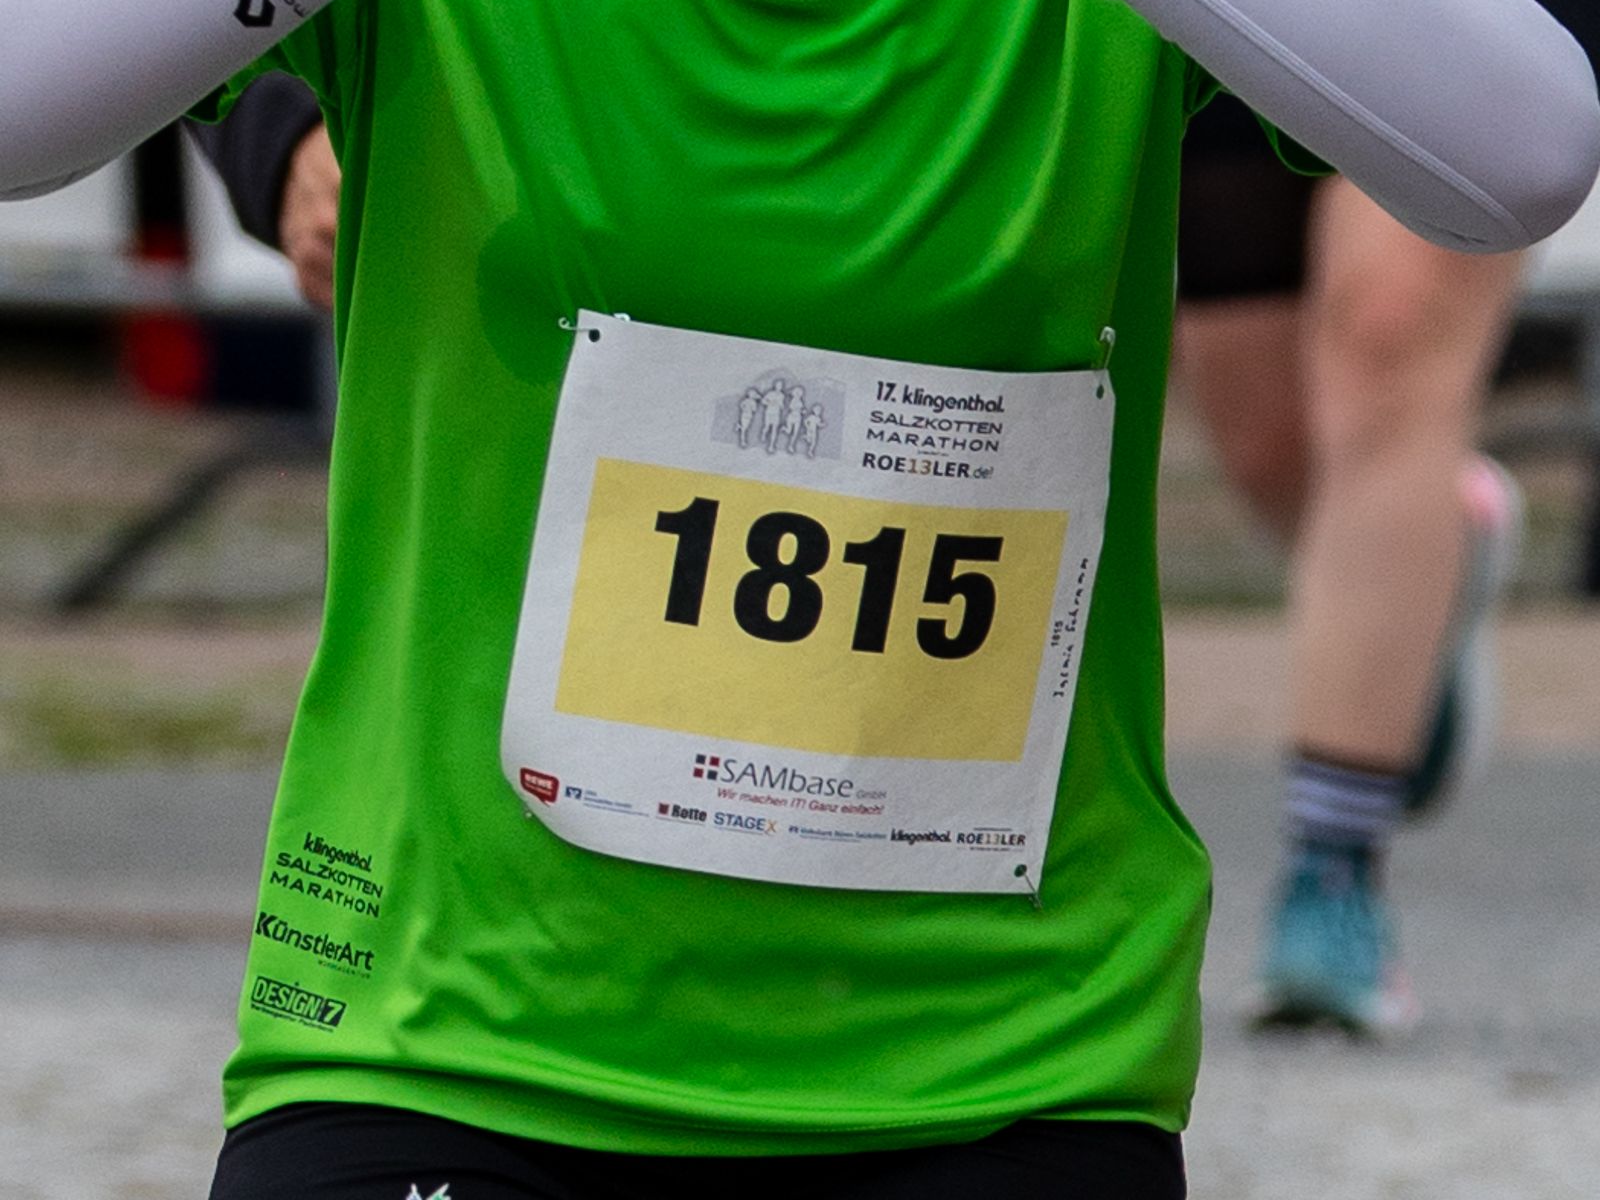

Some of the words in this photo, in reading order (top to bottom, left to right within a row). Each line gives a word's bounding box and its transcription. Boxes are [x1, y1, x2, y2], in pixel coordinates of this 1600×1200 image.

[876, 380, 897, 403] 17.
[902, 384, 1005, 413] klingenthal
[870, 410, 1003, 435] SALZKOTTEN
[866, 428, 1000, 452] MARATHON
[654, 496, 1004, 660] 1815
[1051, 620, 1064, 647] 1815
[720, 759, 854, 798] SAMbase
[717, 787, 737, 800] Wir
[739, 792, 788, 807] machen
[808, 800, 838, 813] Ganz
[276, 852, 384, 899] SALZKOTTEN
[270, 871, 380, 919] MARATHON
